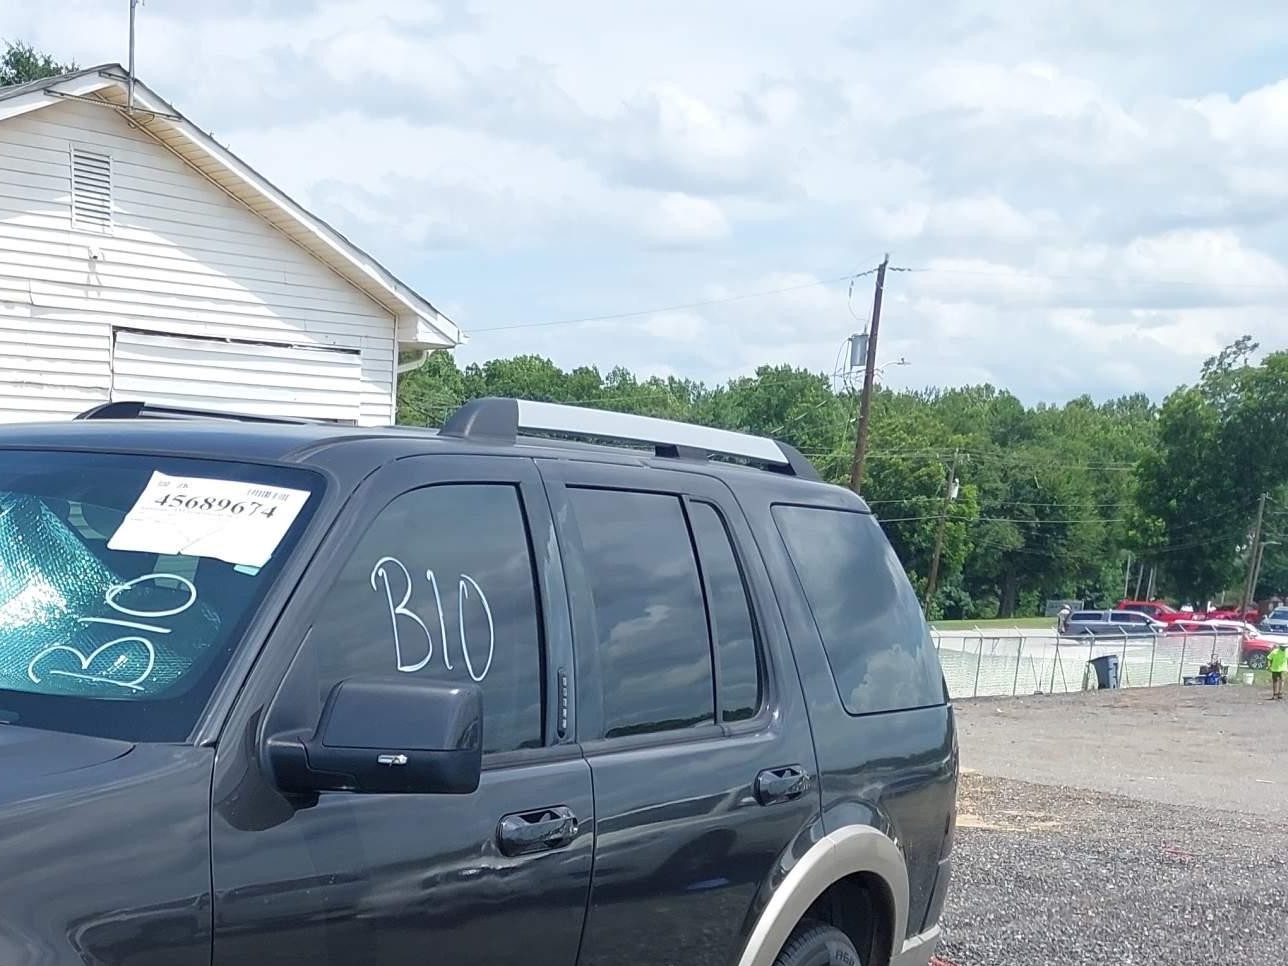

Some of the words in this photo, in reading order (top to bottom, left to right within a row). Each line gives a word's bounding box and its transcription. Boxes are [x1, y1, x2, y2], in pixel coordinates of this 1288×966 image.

[155, 494, 278, 518] 45689674
[28, 573, 197, 690] B10
[371, 556, 494, 681] B10
